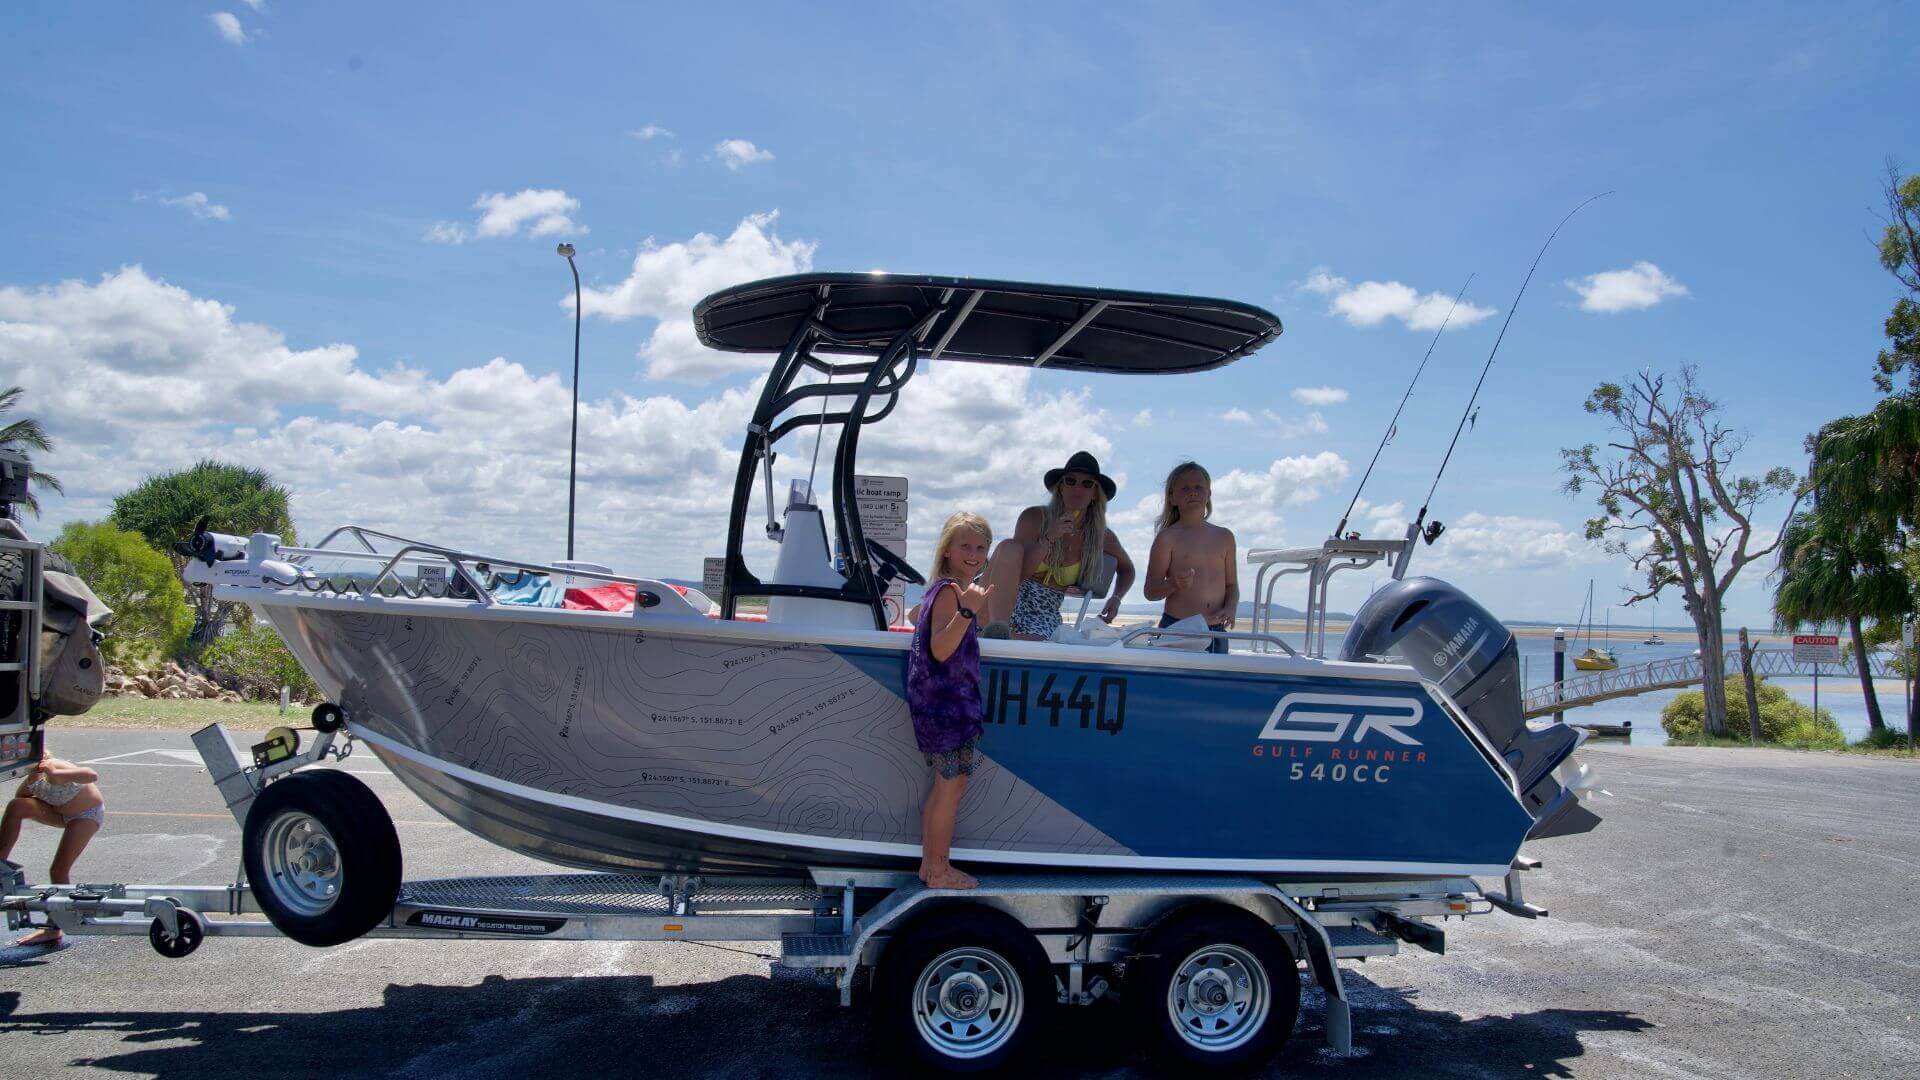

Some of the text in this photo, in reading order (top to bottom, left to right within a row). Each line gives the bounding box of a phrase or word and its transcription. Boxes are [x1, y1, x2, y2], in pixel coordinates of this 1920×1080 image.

[866, 488, 882, 496] boat
[883, 490, 901, 498] ramp
[1443, 616, 1479, 656] YAMAHA
[1258, 692, 1424, 746] GR
[1252, 745, 1427, 762] GULF RUNNER
[1289, 762, 1392, 783] 540CC
[421, 913, 479, 927] MACKAY
